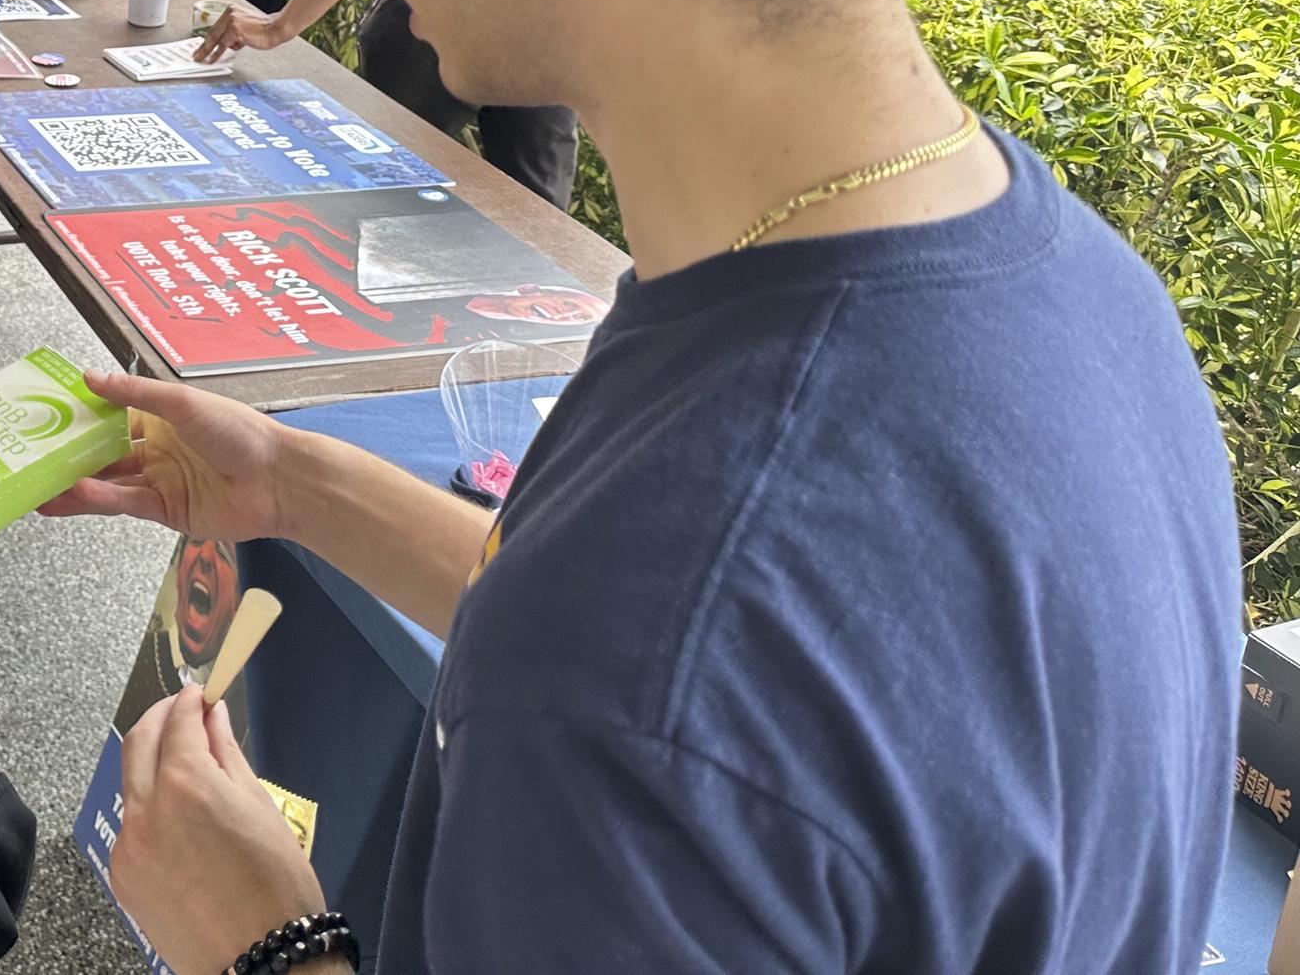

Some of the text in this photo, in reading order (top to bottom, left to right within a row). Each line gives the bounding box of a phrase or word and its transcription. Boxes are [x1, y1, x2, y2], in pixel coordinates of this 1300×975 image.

[211, 93, 278, 136] Register
[266, 136, 293, 149] to
[284, 149, 331, 178] Vote
[212, 120, 267, 150] Here!
[177, 224, 199, 235] at
[122, 240, 162, 267] VOTE
[183, 234, 219, 255] your
[159, 240, 242, 318] take your rights.
[210, 256, 242, 279] door,
[222, 230, 343, 316] RICK SCOTT
[236, 281, 275, 307] don't
[263, 307, 291, 322] let
[279, 323, 310, 344] him
[1243, 766, 1259, 799] SIZE
[1254, 772, 1269, 805] KING
